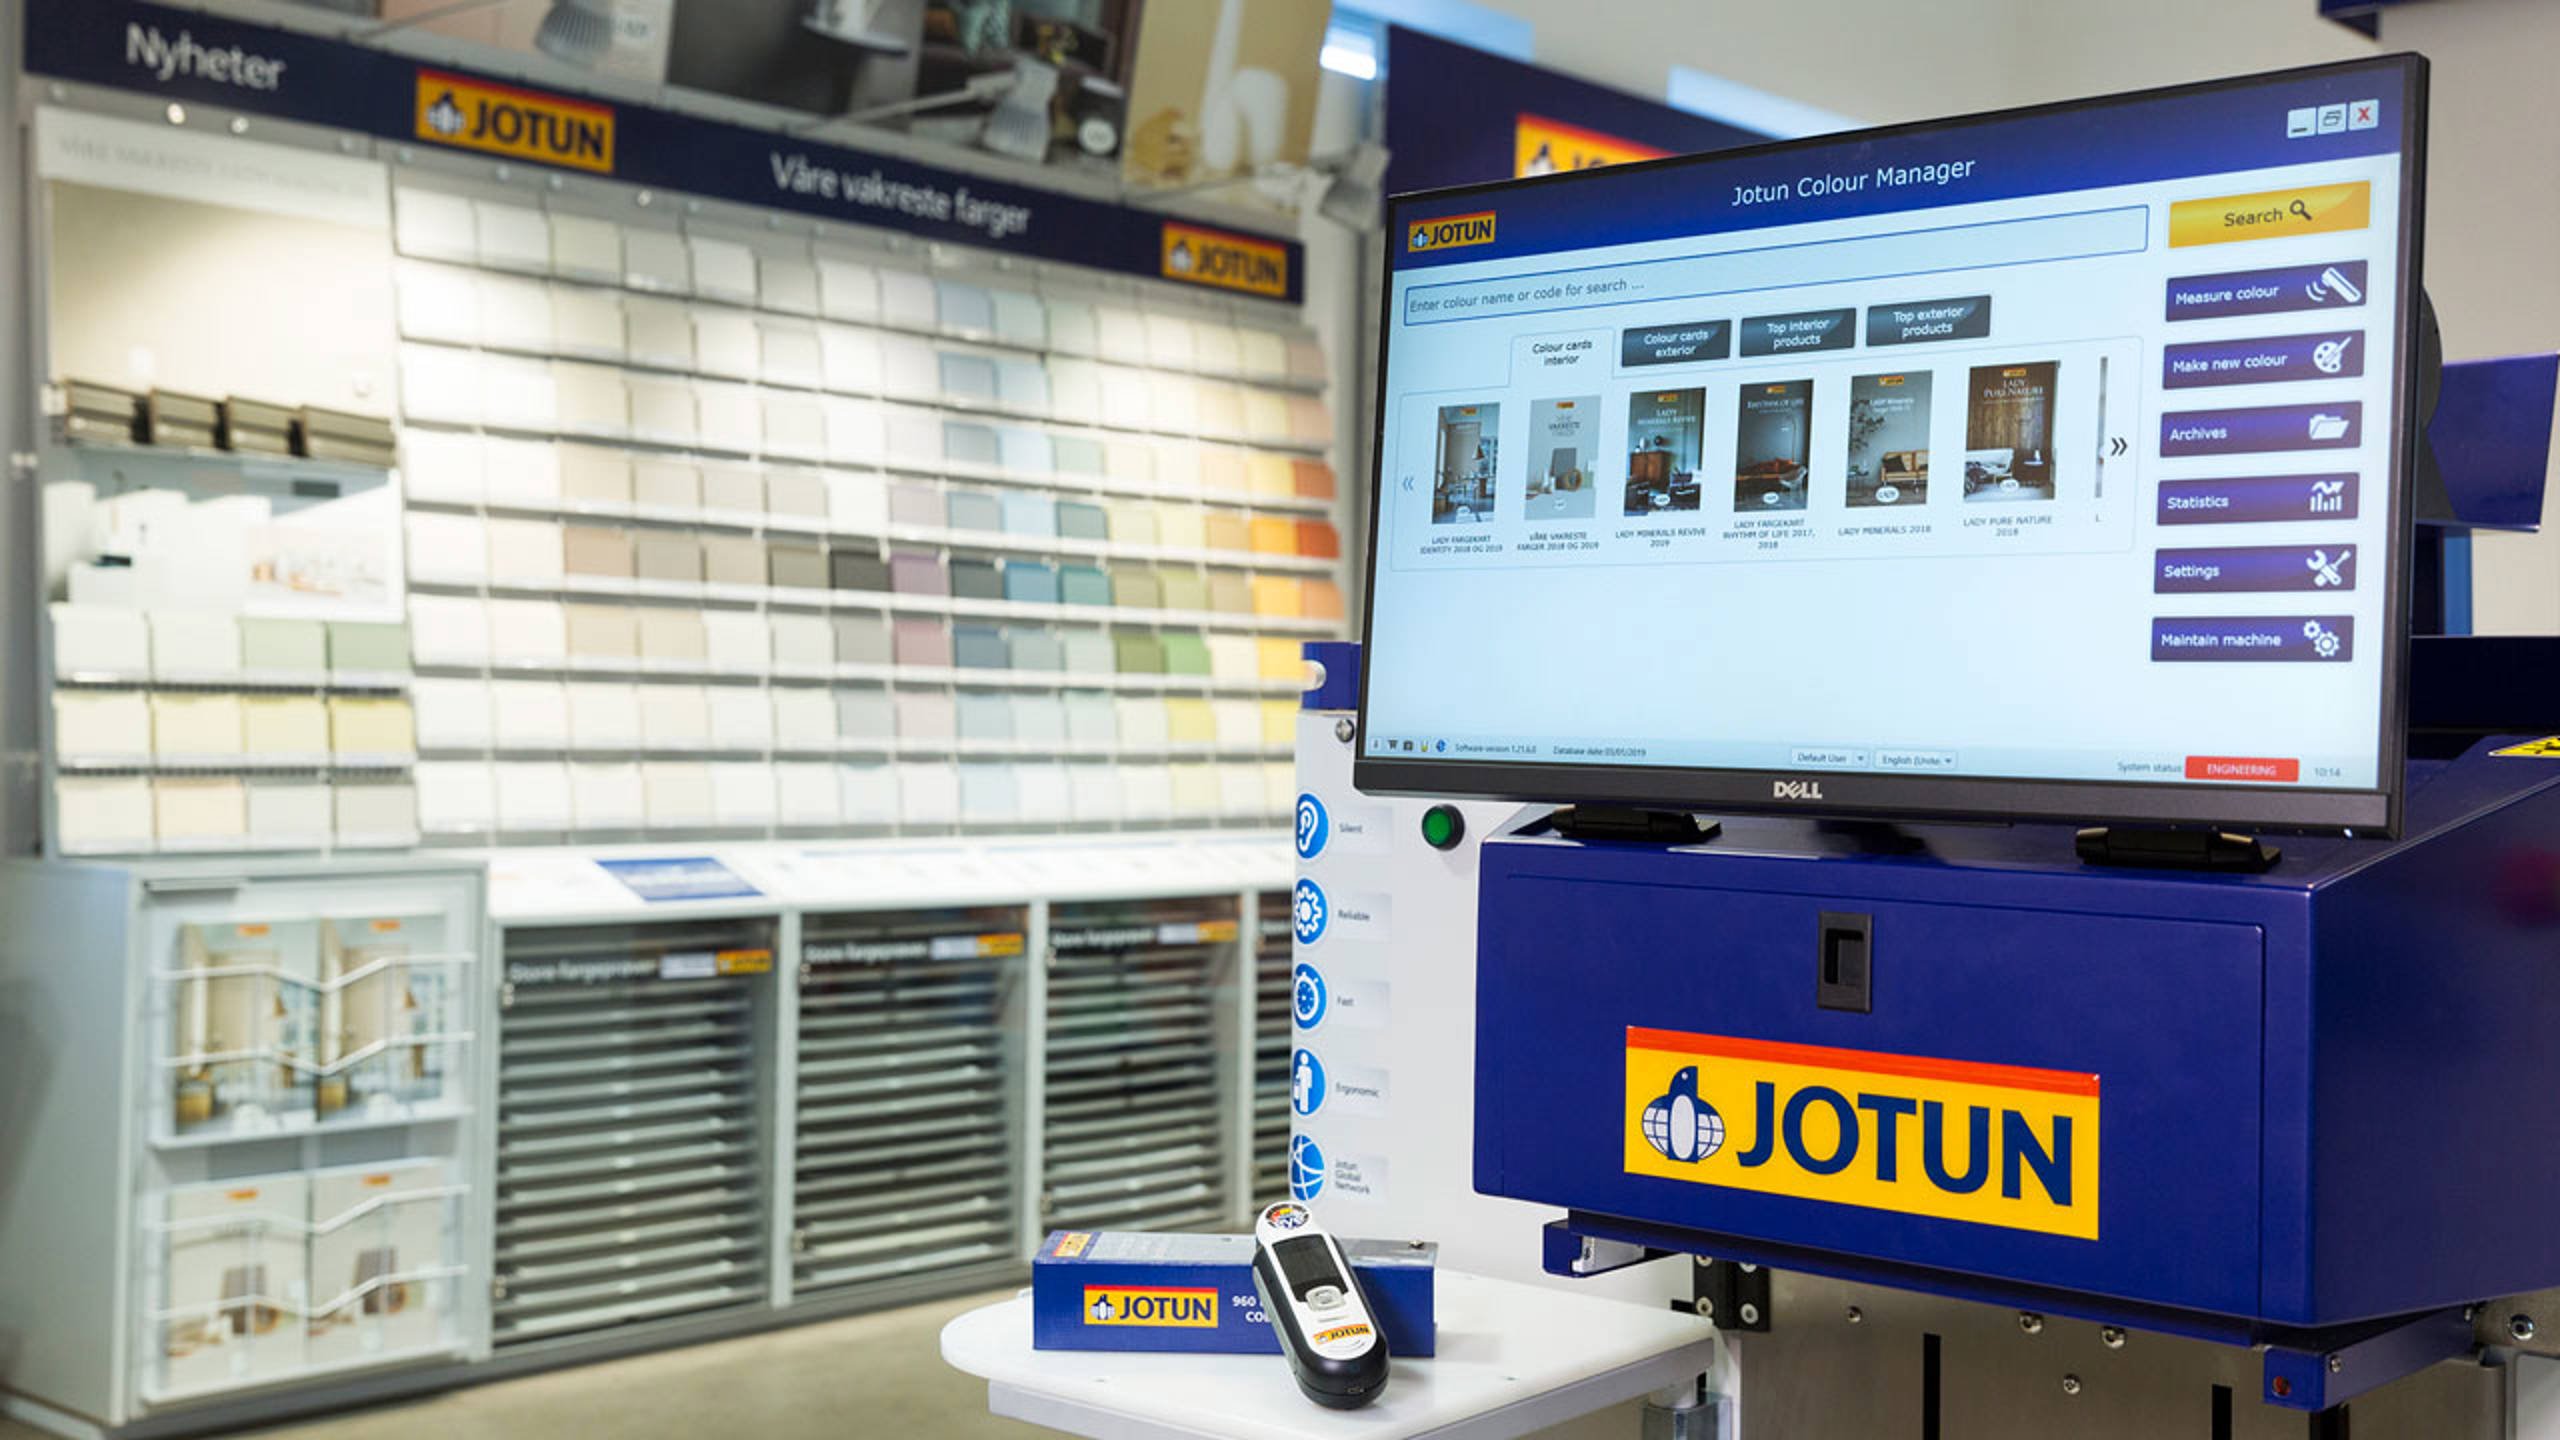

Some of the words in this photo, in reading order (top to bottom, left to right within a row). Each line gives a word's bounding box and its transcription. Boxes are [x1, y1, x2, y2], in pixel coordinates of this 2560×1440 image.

[126, 22, 286, 90] Nyheter
[471, 101, 606, 159] JOTUN
[1732, 181, 1789, 206] Jotun
[1797, 172, 1869, 198] Colour
[1876, 159, 1976, 188] Manager
[769, 151, 839, 198] Våre
[841, 169, 951, 221] vakreste
[955, 186, 1031, 239] farger
[2224, 206, 2283, 227] Search
[1430, 219, 1492, 246] JOTUN
[1198, 243, 1279, 285] JOTUN
[1409, 299, 1440, 312] Enter
[1443, 294, 1477, 309] colour
[1481, 292, 1514, 305] name
[1518, 290, 1531, 301] or
[1533, 284, 1562, 299] code
[1566, 283, 1583, 296] for
[1586, 279, 1627, 294] search
[2175, 289, 2232, 305] Measure
[2236, 286, 2280, 300] colour
[1894, 311, 1914, 326] Top
[1917, 306, 1965, 321] exterior
[1767, 322, 1787, 337] Top
[1789, 317, 1830, 331] interior
[1902, 322, 1953, 339] products
[1644, 332, 1678, 344] Colour
[1680, 329, 1709, 341] cards
[1773, 334, 1821, 350] products
[1532, 343, 1564, 354] Colour
[1566, 339, 1592, 351] cards
[1655, 345, 1696, 358] exterior
[1543, 354, 1579, 366] interior
[2173, 359, 2208, 373] Make
[2212, 357, 2240, 369] new
[2245, 354, 2288, 367] colour
[2169, 427, 2227, 441] Archives
[2167, 495, 2229, 510] Statistics
[2164, 565, 2220, 581] Settings
[2161, 633, 2219, 647] Maintain
[2223, 633, 2281, 647] machine
[1798, 751, 1826, 762] Default
[1882, 754, 1912, 766] English
[2117, 761, 2150, 774] System
[2153, 762, 2182, 773] status
[2207, 763, 2277, 777] ENGINEERING
[1773, 780, 1822, 799] DELL
[1339, 822, 1363, 834] Silent
[1338, 909, 1371, 922] Reliable
[1337, 996, 1354, 1007] Fast
[1737, 1081, 2073, 1207] JOTUN
[1119, 1296, 1211, 1320] JOTUN
[1232, 1295, 1257, 1307] 960
[1331, 1326, 1370, 1340] JOTUN
